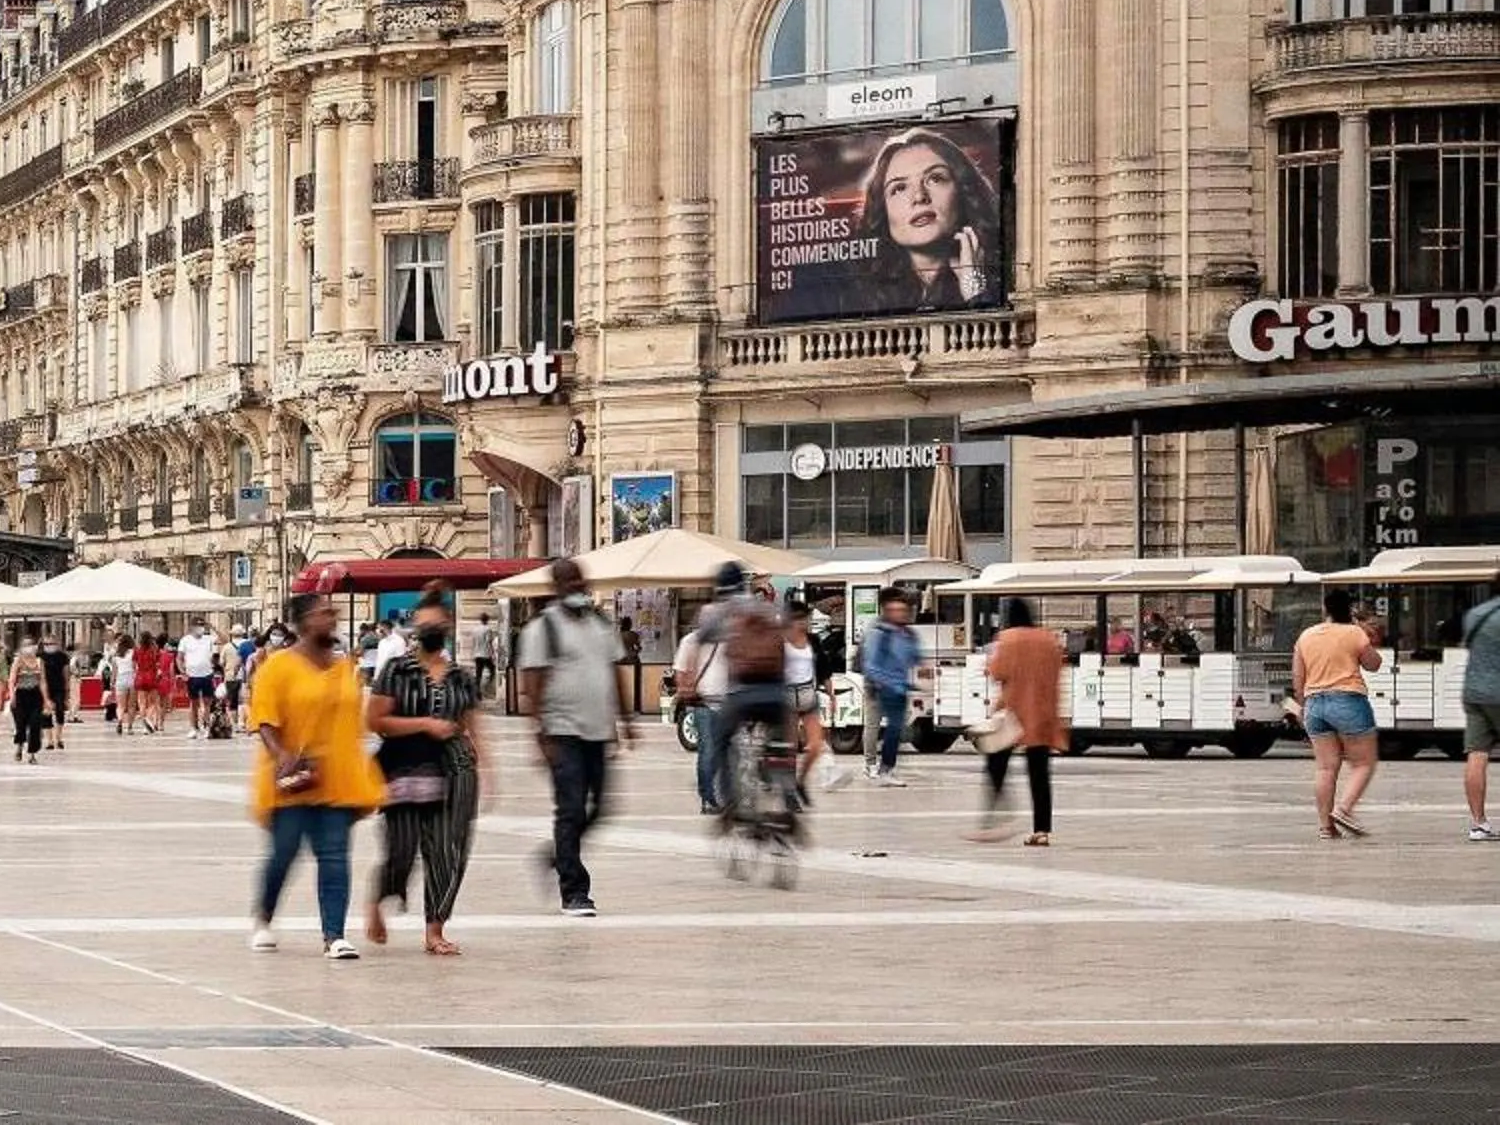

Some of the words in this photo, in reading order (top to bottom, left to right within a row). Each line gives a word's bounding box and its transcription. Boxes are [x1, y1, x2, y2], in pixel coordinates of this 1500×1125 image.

[851, 84, 913, 104] eleom
[770, 153, 797, 174] LES
[770, 176, 809, 198] PLUS
[771, 197, 825, 219] BELLES
[771, 219, 850, 244] HISTOIRES
[771, 238, 879, 267] COMMENCENT
[771, 271, 792, 291] ICI
[826, 445, 941, 472] INDEPENDENCE
